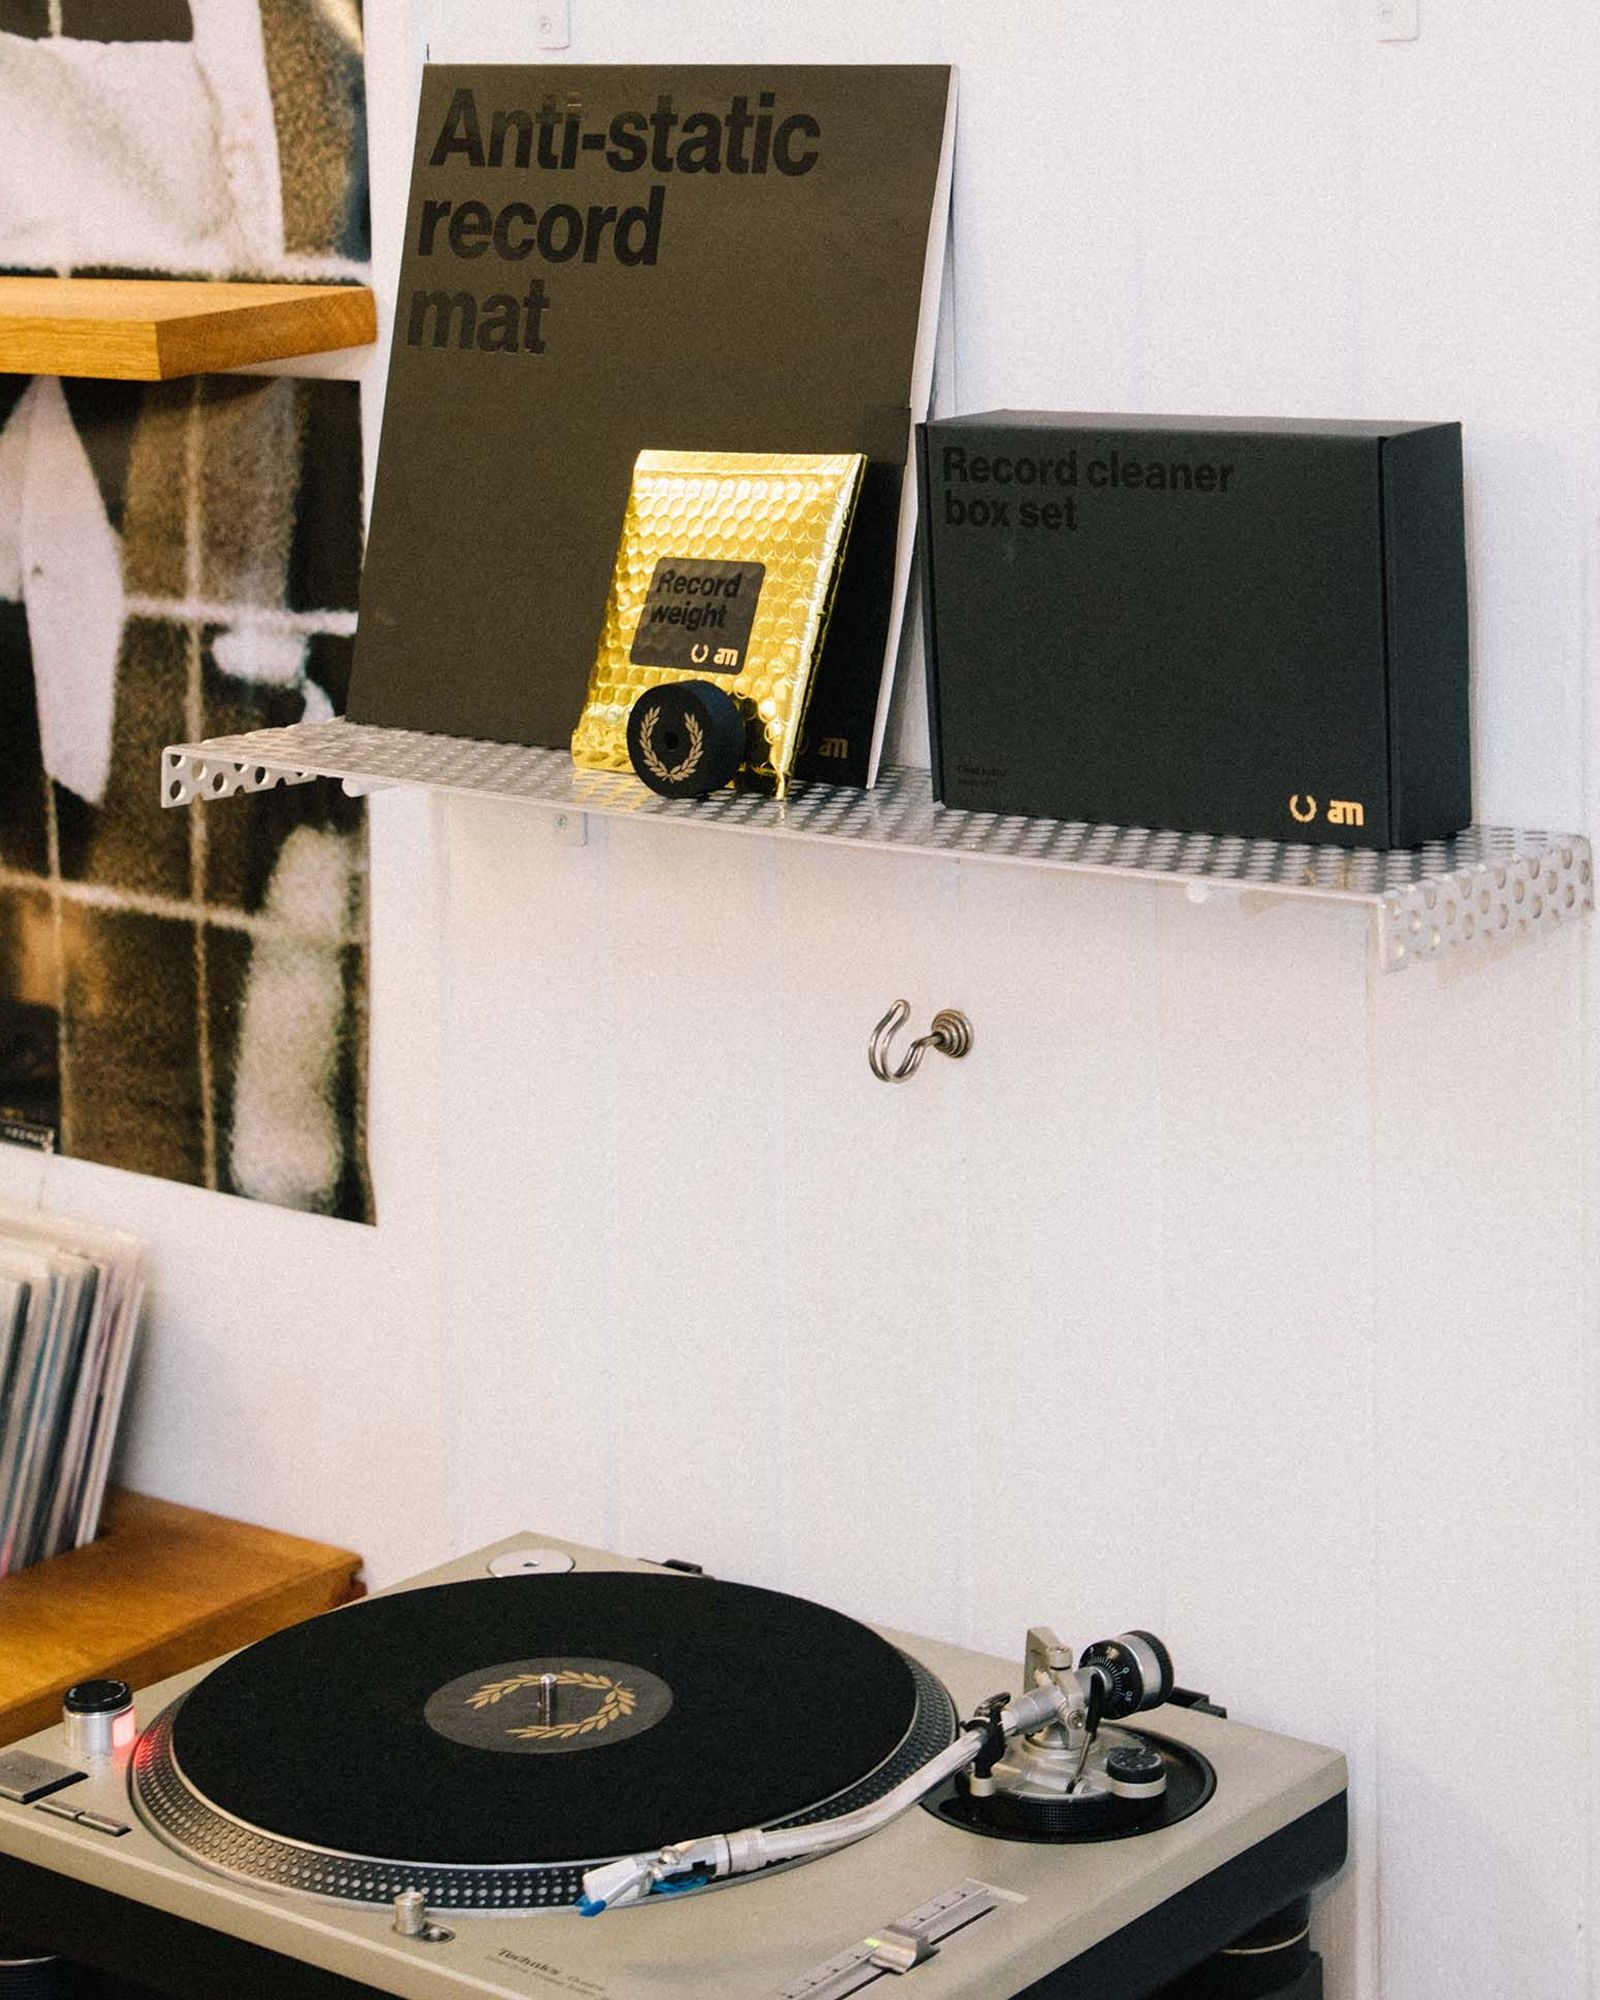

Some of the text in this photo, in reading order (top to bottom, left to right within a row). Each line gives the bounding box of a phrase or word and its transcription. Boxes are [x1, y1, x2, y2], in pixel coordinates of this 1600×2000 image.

[429, 88, 821, 177] Anti-static
[417, 185, 666, 266] record
[406, 278, 551, 355] mat
[942, 446, 1235, 494] Record cleaner
[944, 489, 1079, 531] box set
[656, 568, 743, 599] Record
[650, 600, 728, 632] weight
[713, 647, 739, 667] am
[1327, 799, 1364, 826] am
